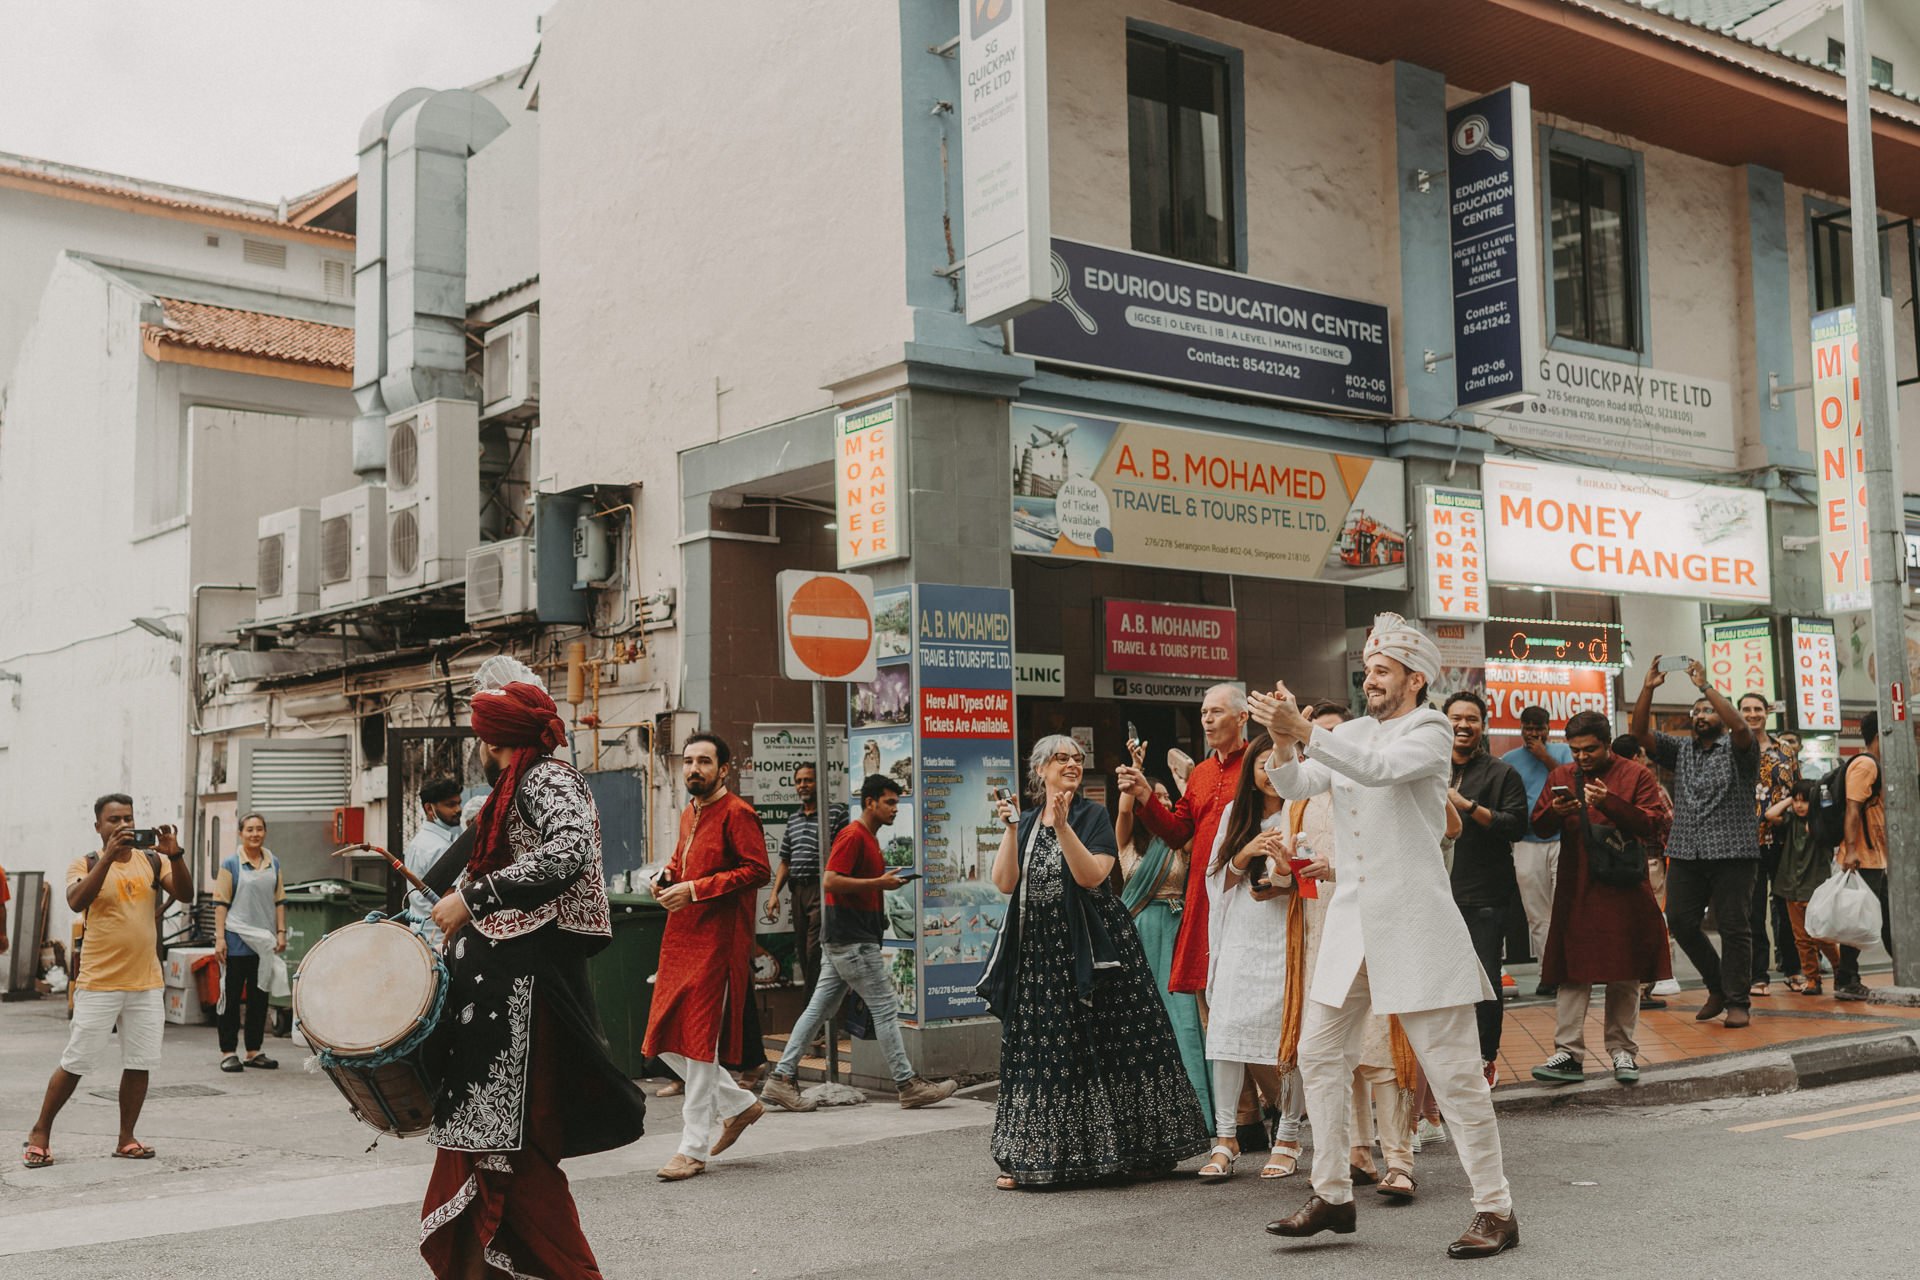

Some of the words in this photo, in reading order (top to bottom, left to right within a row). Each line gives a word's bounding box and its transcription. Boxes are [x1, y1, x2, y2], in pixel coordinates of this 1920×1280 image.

[985, 38, 998, 58] SG
[967, 46, 1017, 87] QUICKPAY
[974, 81, 991, 103] PTE
[993, 70, 1011, 91] LTD
[1455, 171, 1509, 199] EDURIOUS
[1452, 185, 1513, 215] EDUCATION
[1462, 204, 1504, 227] CENTRE
[1454, 245, 1477, 259] IGCSE
[1490, 234, 1515, 248] LEVEL
[1483, 247, 1507, 261] LEVEL
[1468, 269, 1502, 286] SCIENCE
[1471, 261, 1498, 274] MATHS
[1084, 266, 1191, 308] EDURIOUS
[1196, 289, 1308, 330] EDUCATION
[1311, 312, 1383, 345] CENTRE
[1465, 301, 1508, 321] Contact:
[1134, 312, 1162, 326] IGCSE
[1170, 319, 1177, 329] O
[1179, 321, 1208, 335] LEVEL
[1215, 327, 1224, 337] IB
[1231, 331, 1239, 340] A
[1240, 332, 1267, 346] LEVEL
[1274, 339, 1303, 352] MATHS
[1310, 345, 1345, 360] SCIENCE
[1463, 313, 1511, 336] 85421242
[1187, 347, 1240, 369] Contact:
[1242, 356, 1301, 379] 85421242
[1471, 358, 1506, 376] #02-06
[1345, 374, 1386, 392] #02-06
[1464, 377, 1486, 392] (2nd
[1487, 370, 1514, 386] floor)
[1556, 362, 1645, 397] QUICKPAY
[1650, 379, 1678, 403] PTE
[1683, 385, 1712, 408] LTD
[1347, 388, 1365, 400] (2nd
[1365, 390, 1387, 404] floor)
[1546, 389, 1562, 401] 276
[1563, 392, 1605, 408] Serangoon
[1606, 399, 1627, 412] Road
[1115, 444, 1144, 479] A.
[1151, 448, 1178, 483] B.
[1184, 453, 1327, 501] MOHAMED
[1816, 344, 1850, 584] MONEY
[844, 434, 863, 557] MONEY
[868, 428, 887, 552] CHANGER
[1064, 485, 1076, 495] All
[1077, 486, 1097, 498] Kind
[1062, 501, 1071, 510] of
[1073, 501, 1100, 513] Ticket
[1112, 488, 1182, 516] TRAVEL
[1186, 497, 1198, 517] &
[1201, 499, 1258, 525] TOURS
[1261, 506, 1295, 529] PTE.
[1299, 511, 1331, 533] LTD.
[1500, 494, 1643, 540] MONEY
[1062, 514, 1101, 527] Available
[1071, 529, 1092, 540] Here
[1174, 539, 1210, 552] Serangoon
[1212, 544, 1228, 554] Road
[1254, 548, 1287, 562] Singapore
[1433, 509, 1454, 613] MONEY
[1459, 512, 1480, 613] CHANGER
[1570, 542, 1757, 587] CHANGER
[920, 609, 933, 638] A.
[934, 609, 947, 639] B.
[948, 610, 1009, 641] MOHAMED
[1151, 615, 1221, 639] MOHAMED
[920, 648, 948, 667] TRAVEL
[949, 649, 955, 667] &
[955, 649, 981, 669] TOURS
[1112, 639, 1147, 657] TRAVEL
[1149, 643, 1157, 656] &
[1159, 643, 1189, 658] TOURS
[1190, 646, 1210, 660] PTE.
[1211, 647, 1230, 661] LTD.
[1711, 641, 1732, 693] MON
[1743, 638, 1765, 688] CHAN
[1518, 670, 1571, 686] EXCHANGE
[1797, 636, 1816, 726] MONEY
[1818, 637, 1835, 726] CHANGER
[1129, 683, 1142, 695] SG
[1145, 683, 1193, 697] QUICKPAY
[926, 693, 946, 710] Here
[947, 693, 959, 710] All
[960, 694, 984, 714] Types
[984, 694, 995, 710] Of
[995, 694, 1008, 711] Air
[1509, 689, 1606, 721] CHANGER
[924, 715, 954, 733] Tickets
[955, 717, 970, 733] Are
[970, 717, 1010, 733] Available.
[776, 810, 789, 819] Us
[928, 985, 950, 995] 276/278
[947, 997, 977, 1006] Singapore
